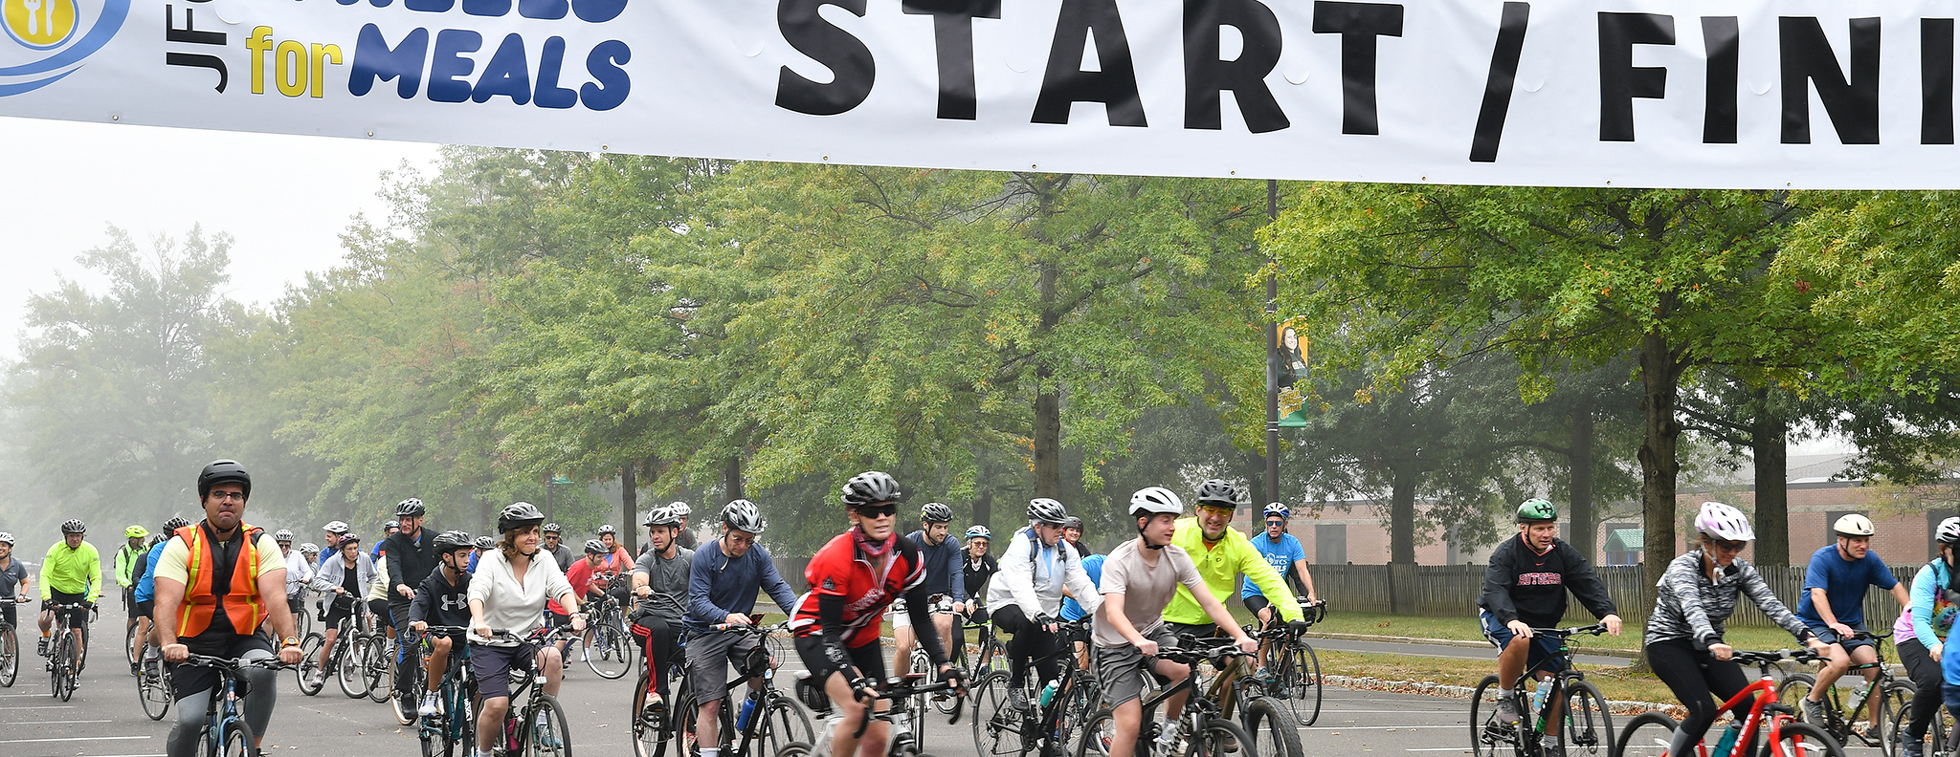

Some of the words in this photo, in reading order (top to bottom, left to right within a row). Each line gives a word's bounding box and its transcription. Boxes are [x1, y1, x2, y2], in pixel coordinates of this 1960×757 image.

[166, 0, 228, 93] JF
[246, 26, 343, 98] for
[348, 23, 631, 111] MEALS
[775, 0, 1403, 135] START
[1469, 2, 1530, 162] /
[1597, 11, 1954, 144] FINI
[1517, 572, 1562, 586] RUTGERS
